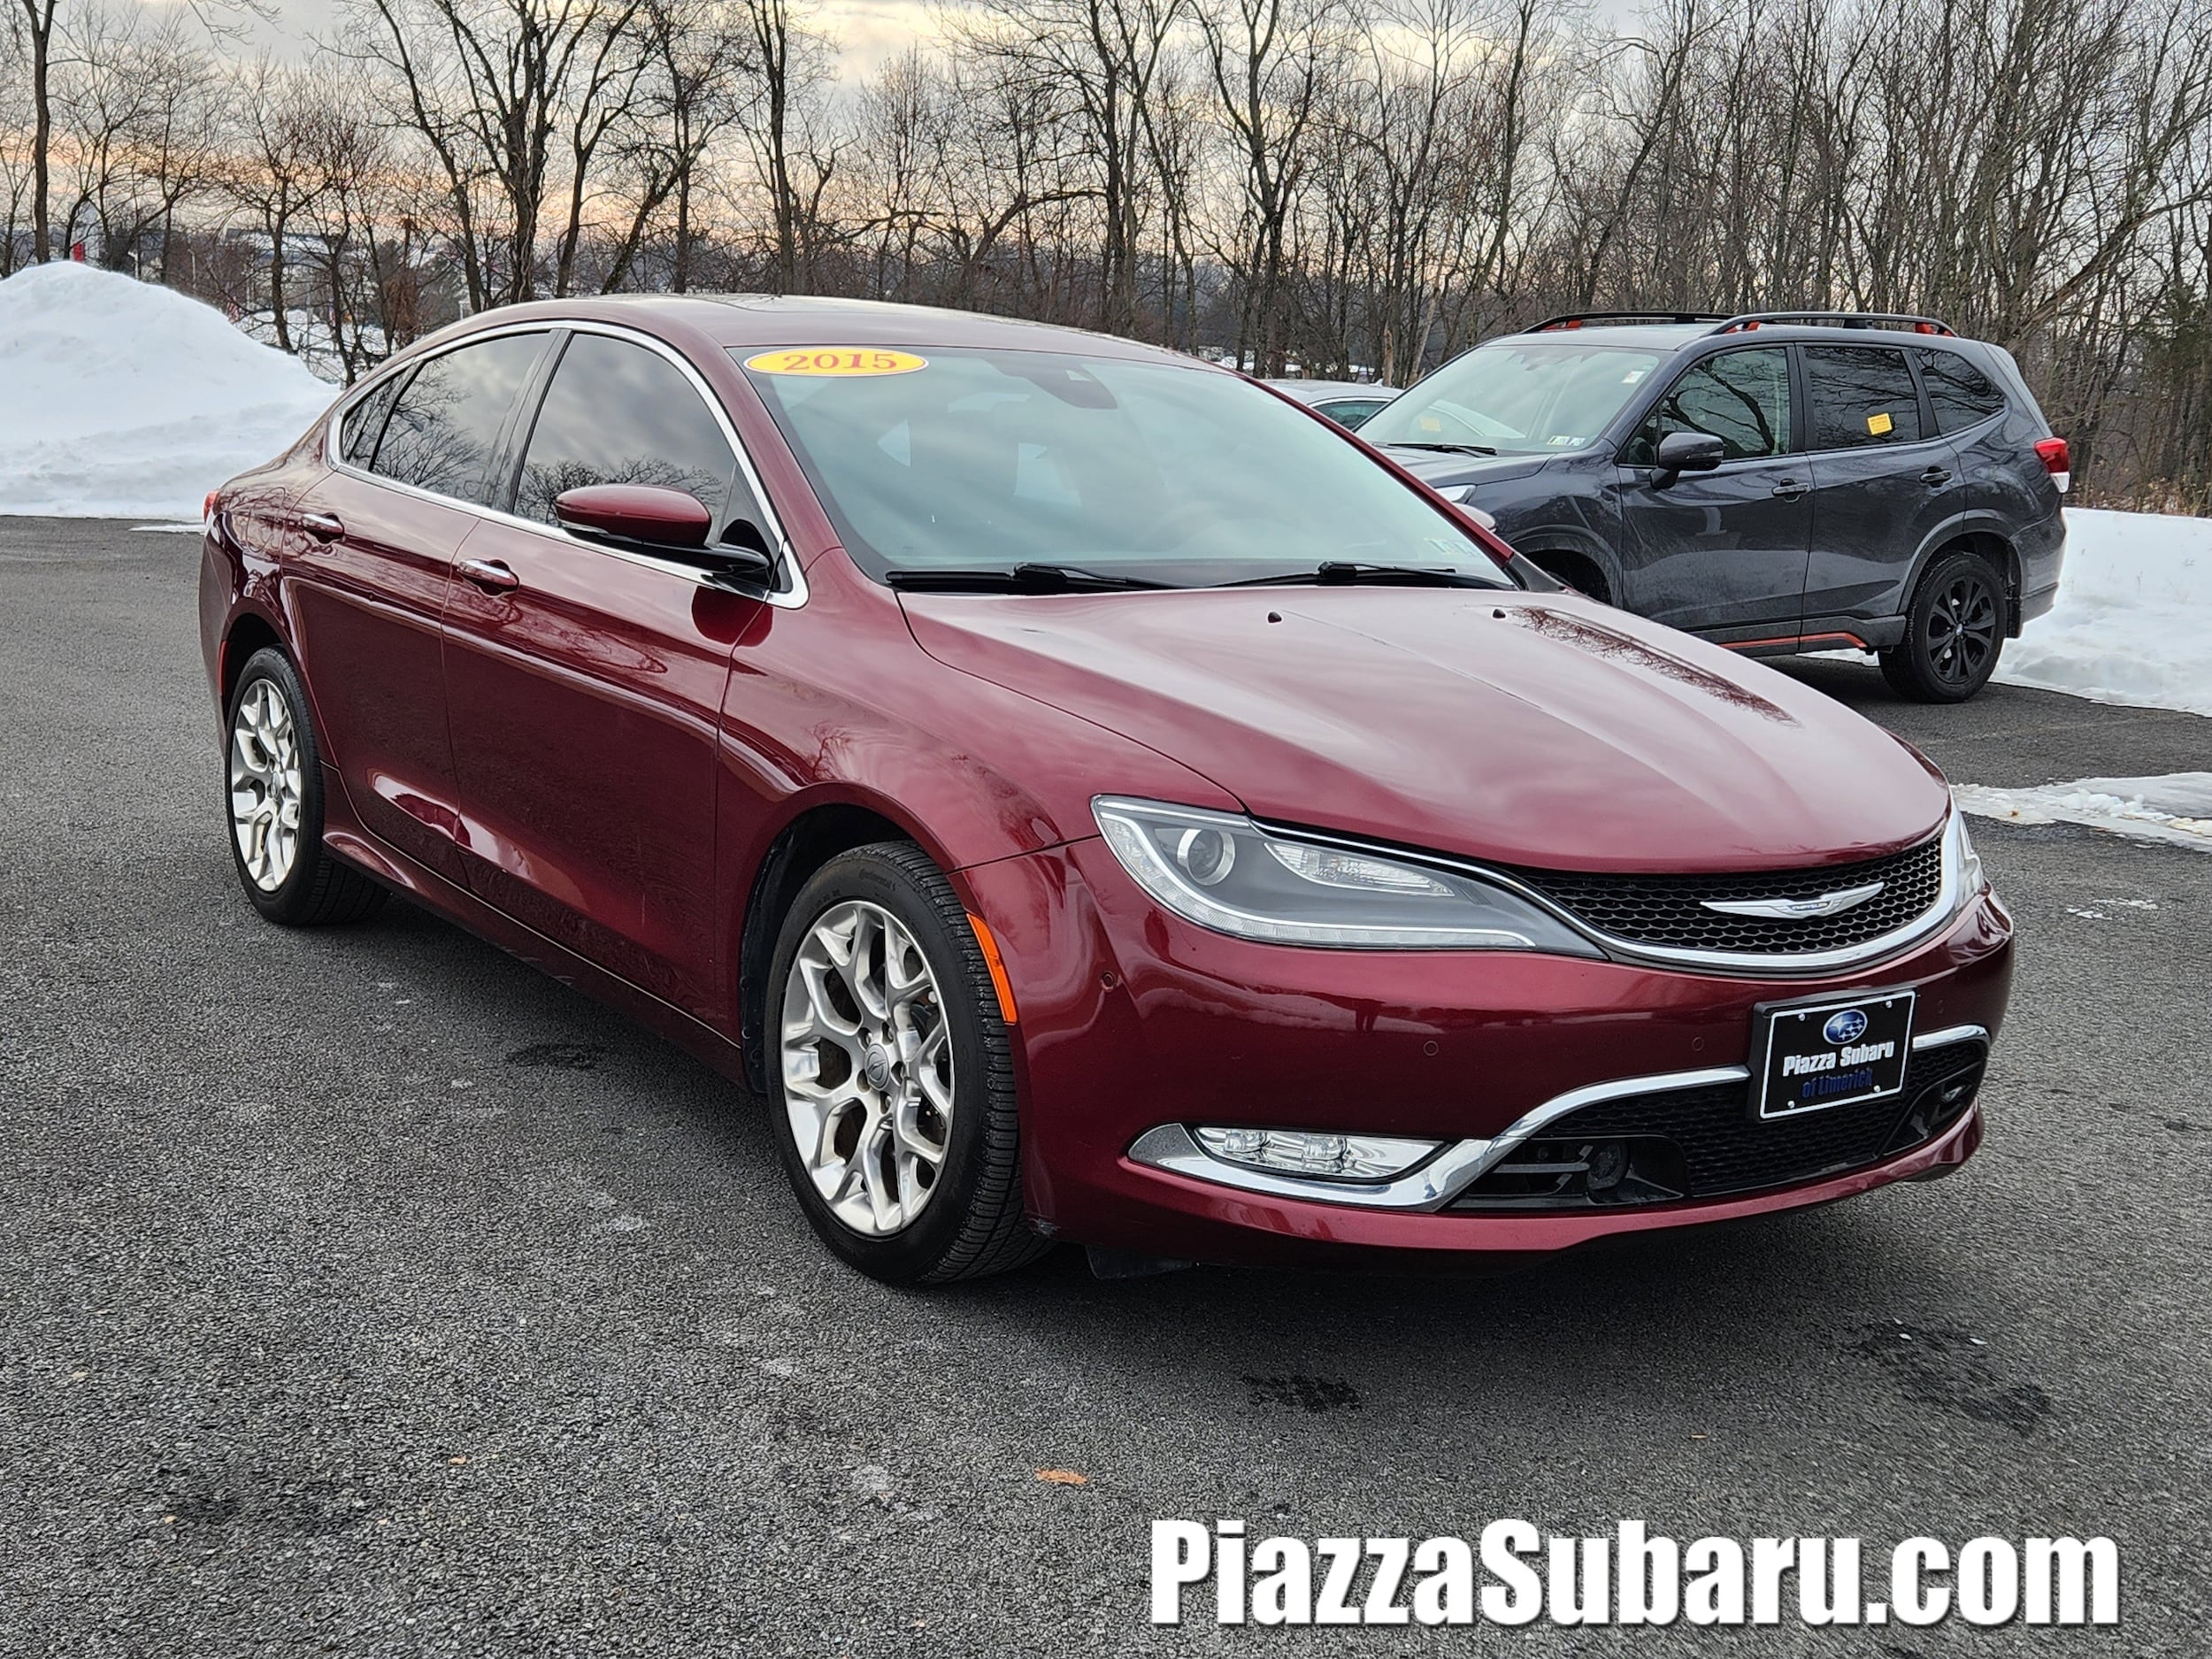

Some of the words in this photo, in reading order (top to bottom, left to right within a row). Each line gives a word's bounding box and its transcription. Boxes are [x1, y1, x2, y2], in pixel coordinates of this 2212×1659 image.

[783, 353, 896, 371] 2015
[1783, 1052, 1837, 1076] Piazza
[1840, 1041, 1894, 1066] Subaru
[1802, 1078, 1816, 1097] of
[1817, 1067, 1872, 1096] Limerick
